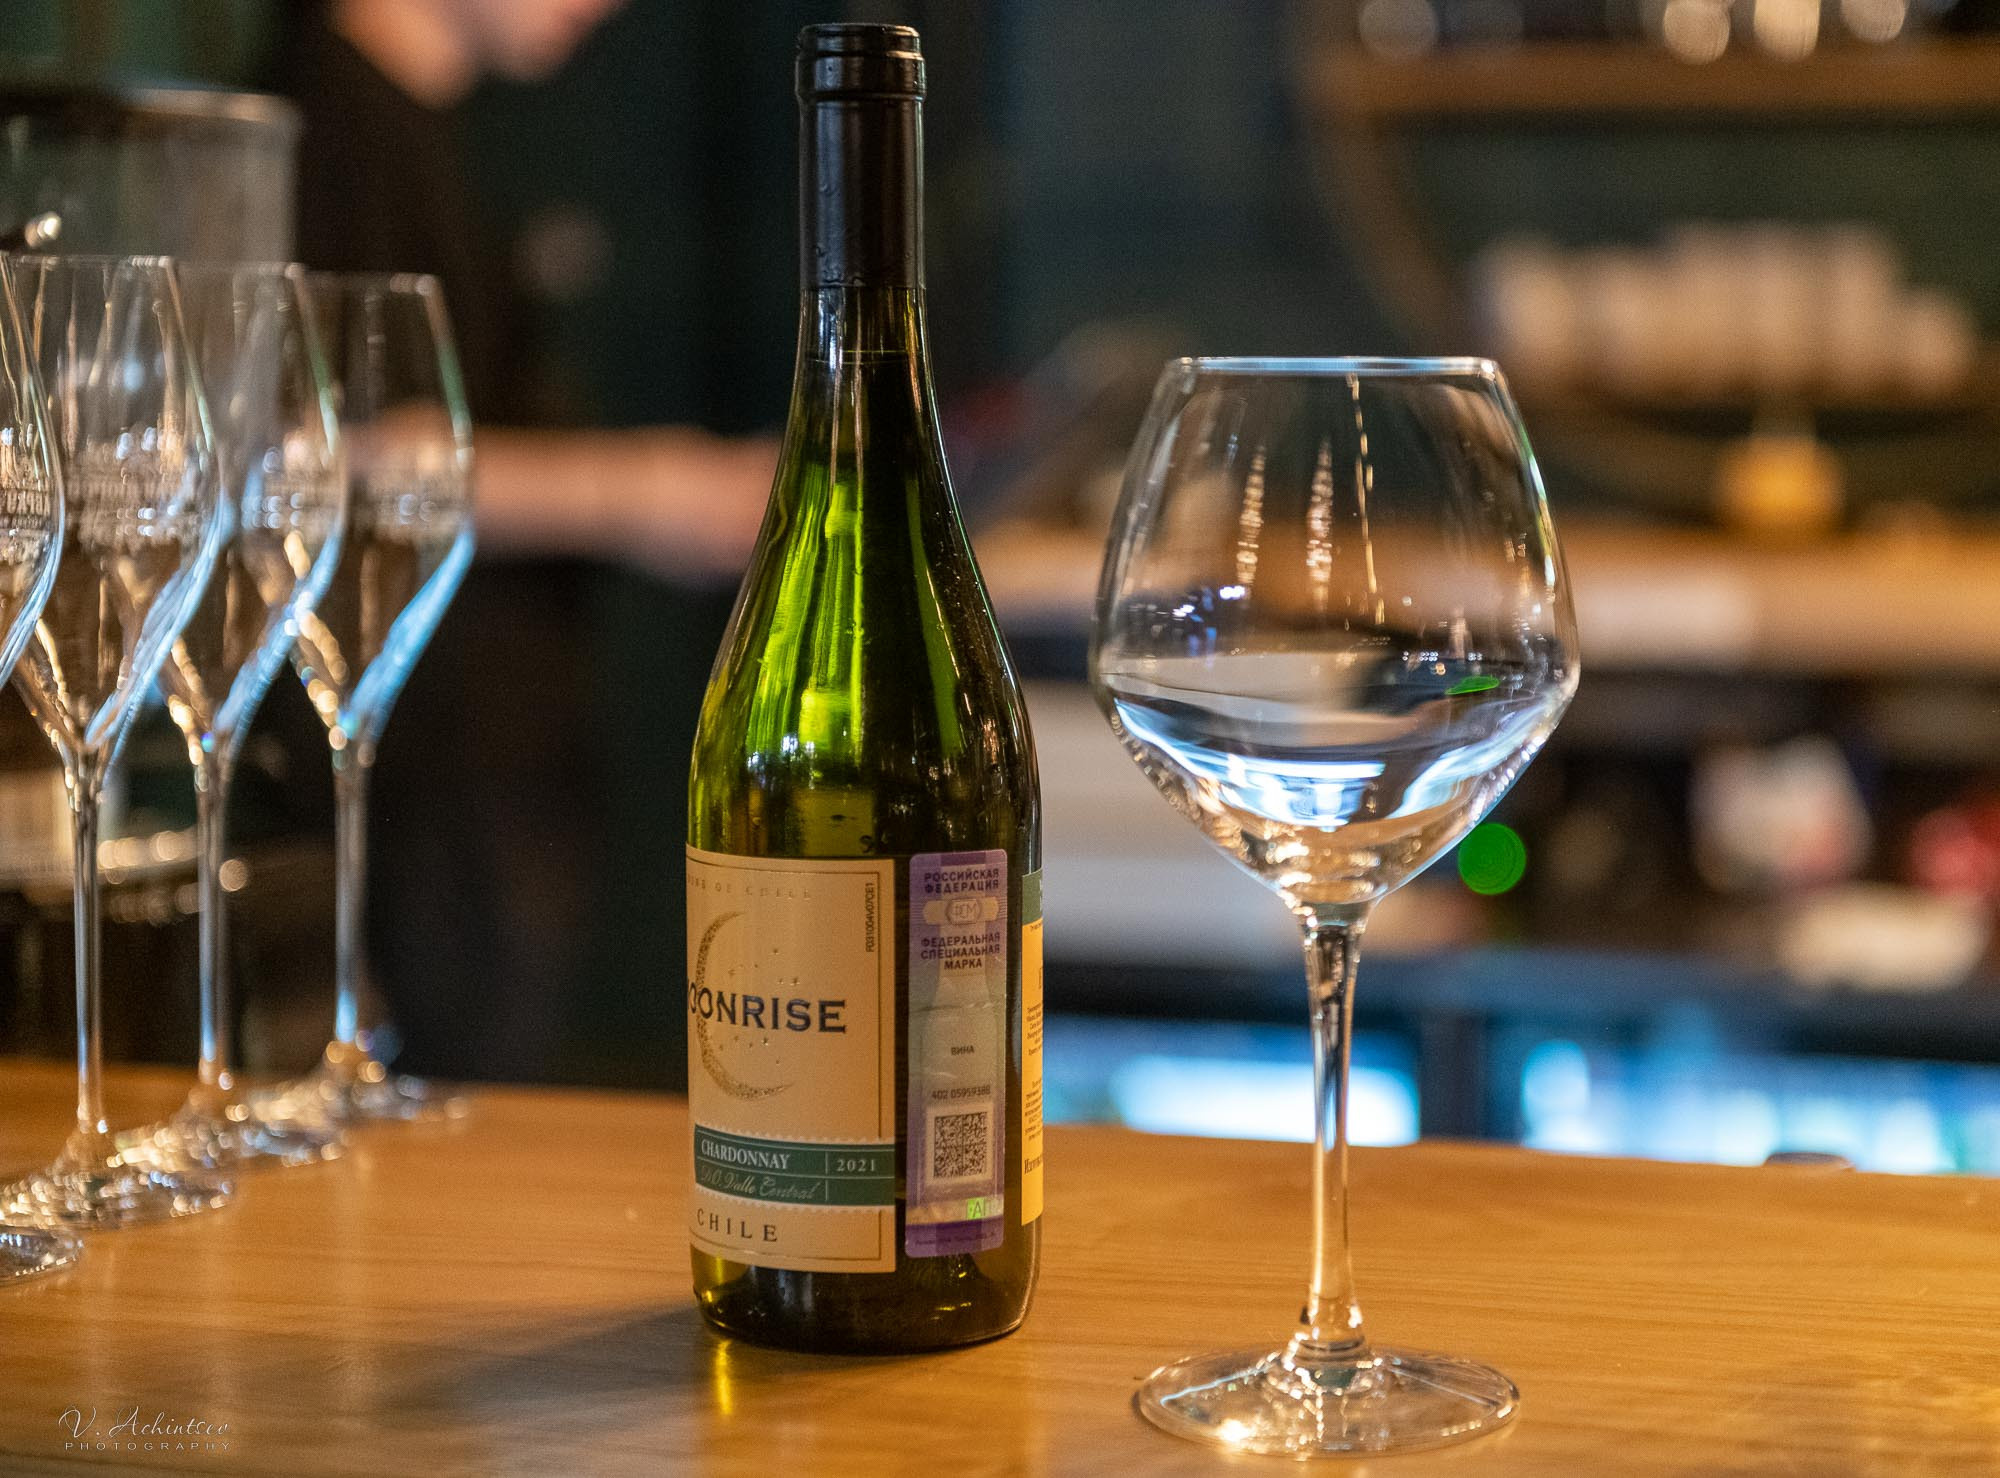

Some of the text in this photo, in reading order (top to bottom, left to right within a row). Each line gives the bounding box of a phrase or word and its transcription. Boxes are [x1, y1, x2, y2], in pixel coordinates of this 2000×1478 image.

[924, 868, 1000, 882] РОССИЙСКАЯ
[925, 880, 999, 894] ФЕДЕРАЦИЯ
[921, 932, 1000, 947] ФЕДЕРАЛЬНАЯ
[921, 944, 1000, 959] СПЕЦИАЛЬНАЯ
[944, 958, 982, 970] МАРКА
[688, 978, 847, 1034] OONRISE
[951, 1045, 975, 1056] ВИНА
[701, 1139, 876, 1172] CHARDONNAY 2021
[697, 1208, 778, 1243] CHILE
